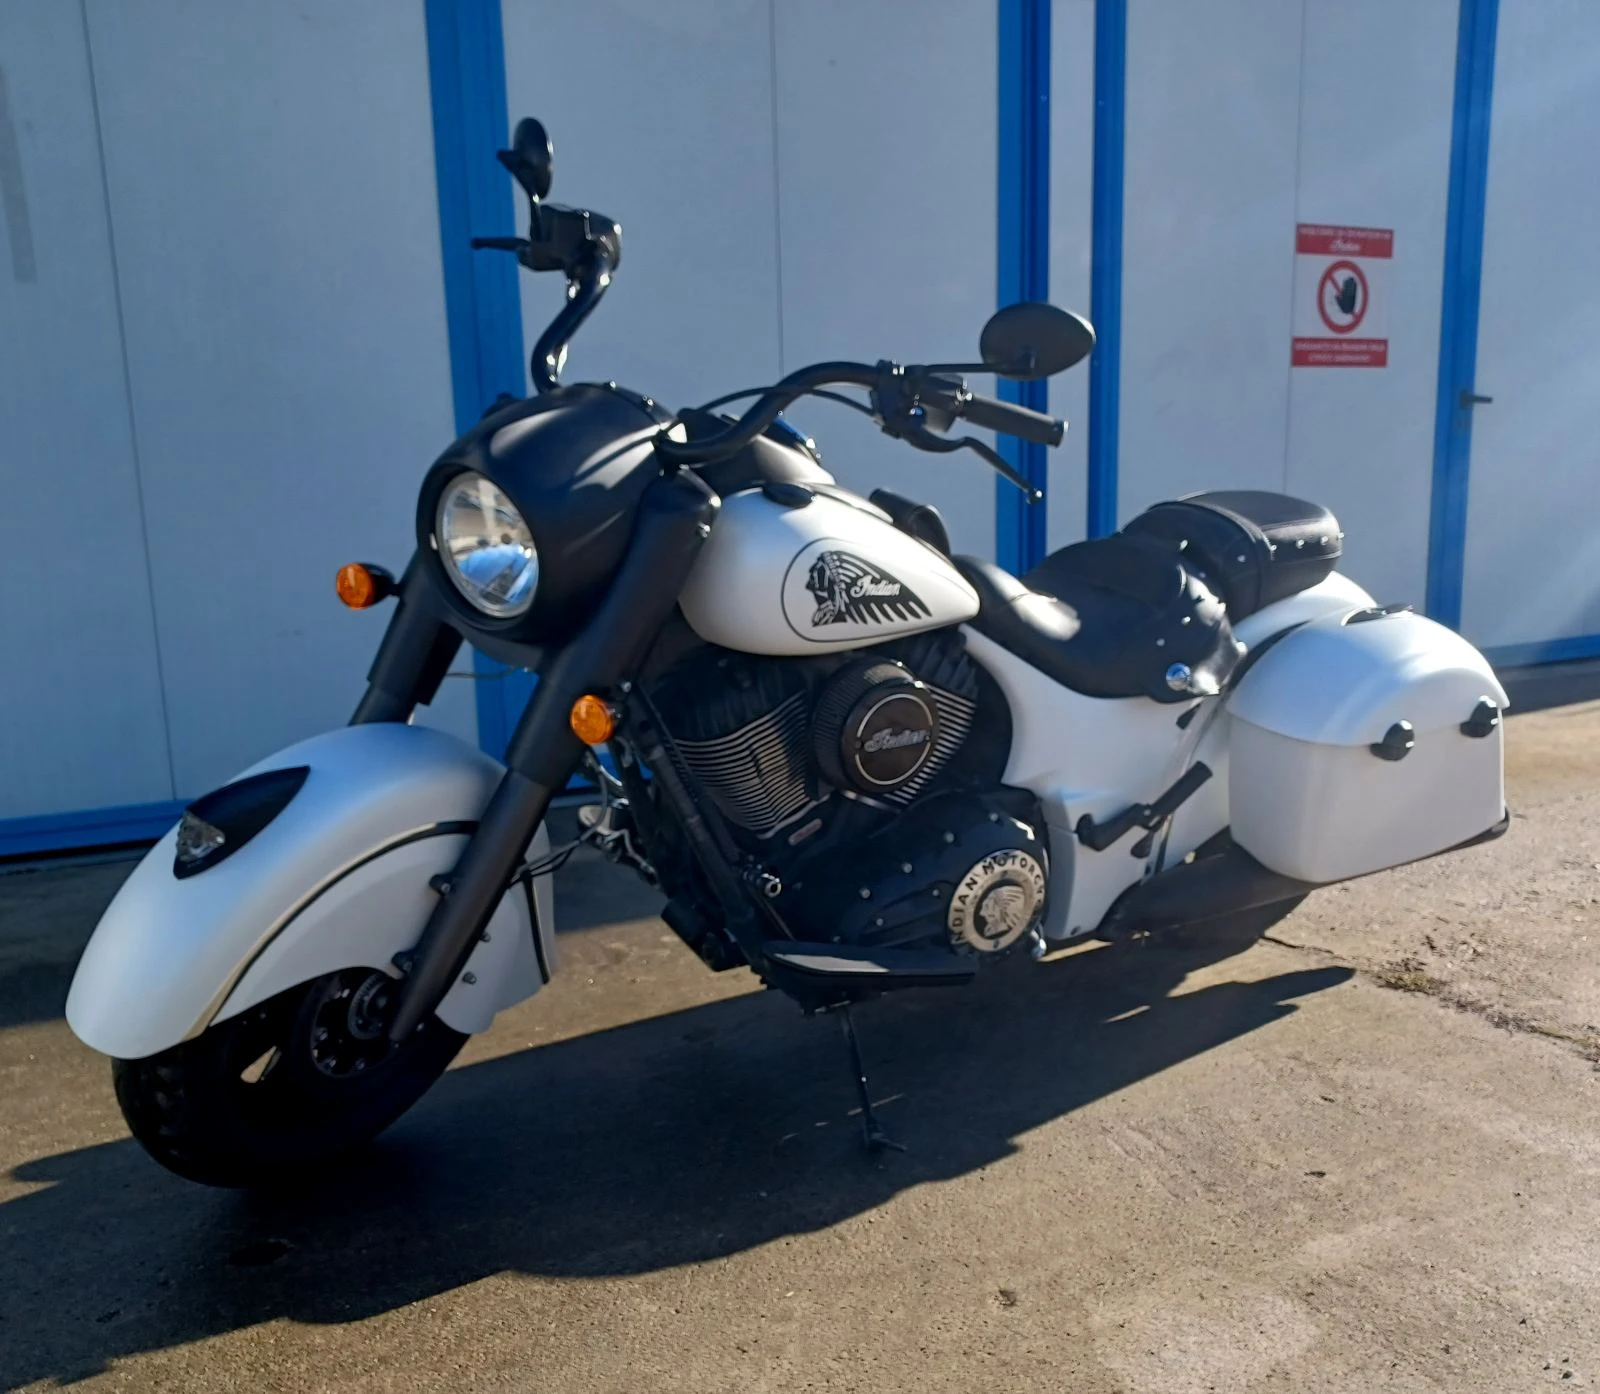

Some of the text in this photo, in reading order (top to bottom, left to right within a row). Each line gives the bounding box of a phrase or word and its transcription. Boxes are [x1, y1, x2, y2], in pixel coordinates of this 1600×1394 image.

[850, 574, 901, 598] Indian
[864, 728, 928, 753] Indian
[952, 853, 1044, 942] NDIAN MOTORC
